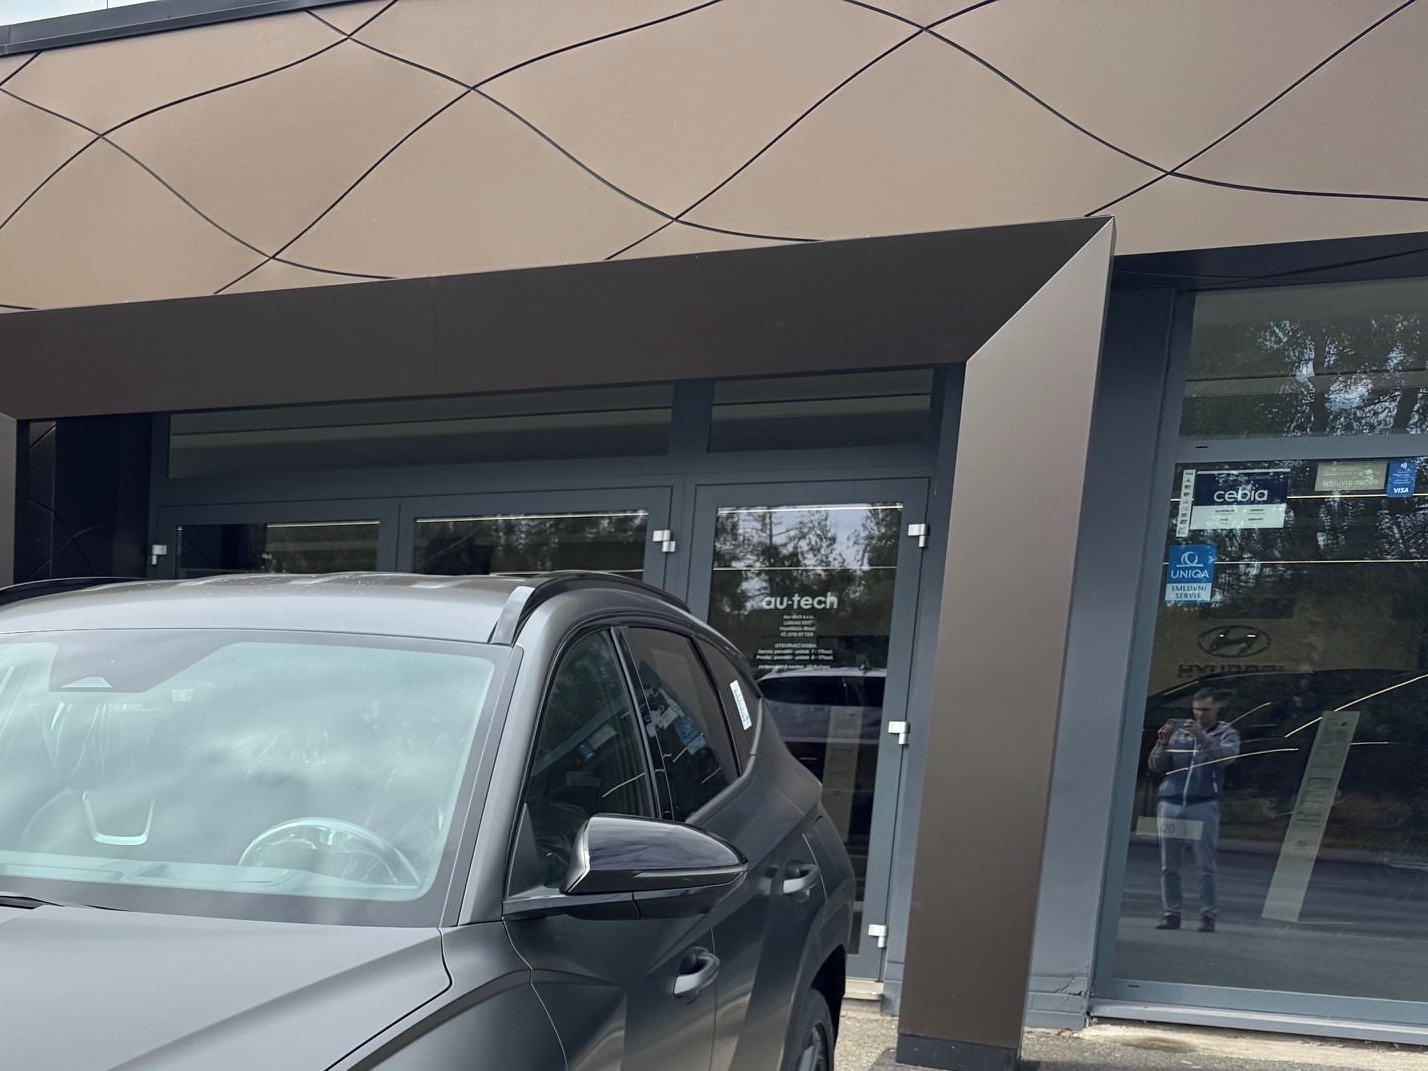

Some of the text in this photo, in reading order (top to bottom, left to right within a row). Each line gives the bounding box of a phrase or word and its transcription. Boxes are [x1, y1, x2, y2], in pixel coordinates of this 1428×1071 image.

[1213, 485, 1269, 502] cebia
[1171, 569, 1210, 579] UNIQA
[762, 592, 839, 610] au-tech
